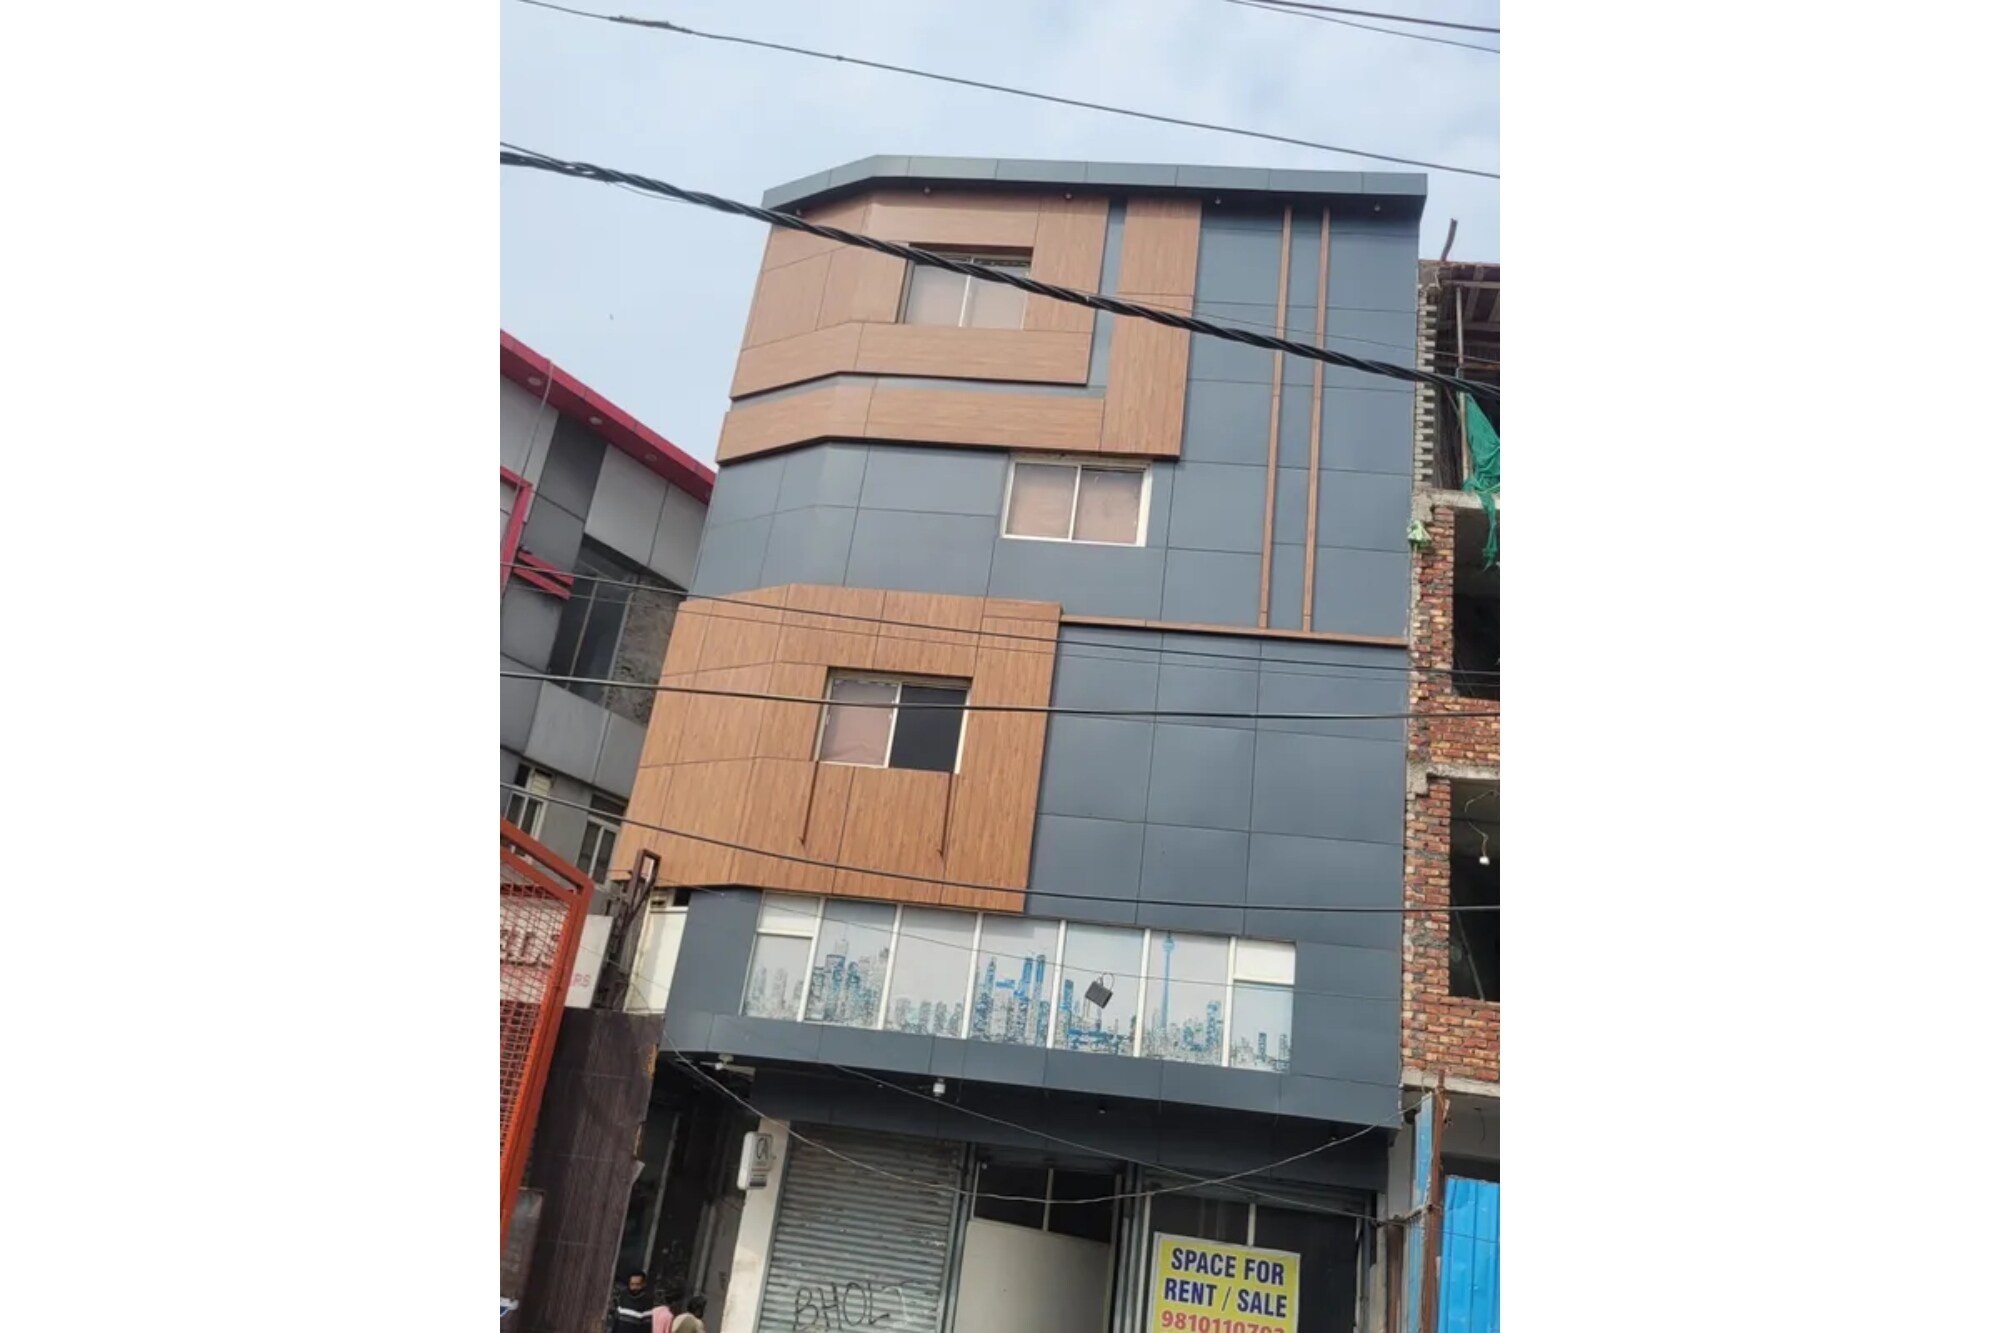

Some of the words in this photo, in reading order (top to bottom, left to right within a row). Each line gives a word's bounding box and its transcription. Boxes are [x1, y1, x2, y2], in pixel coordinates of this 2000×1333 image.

[1171, 1248, 1236, 1278] SPACE
[1244, 1259, 1284, 1285] FOR
[1164, 1278, 1217, 1307] RENT
[1222, 1286, 1231, 1311] /
[1237, 1289, 1287, 1318] SALE
[1162, 1310, 1285, 1333] 98101107
